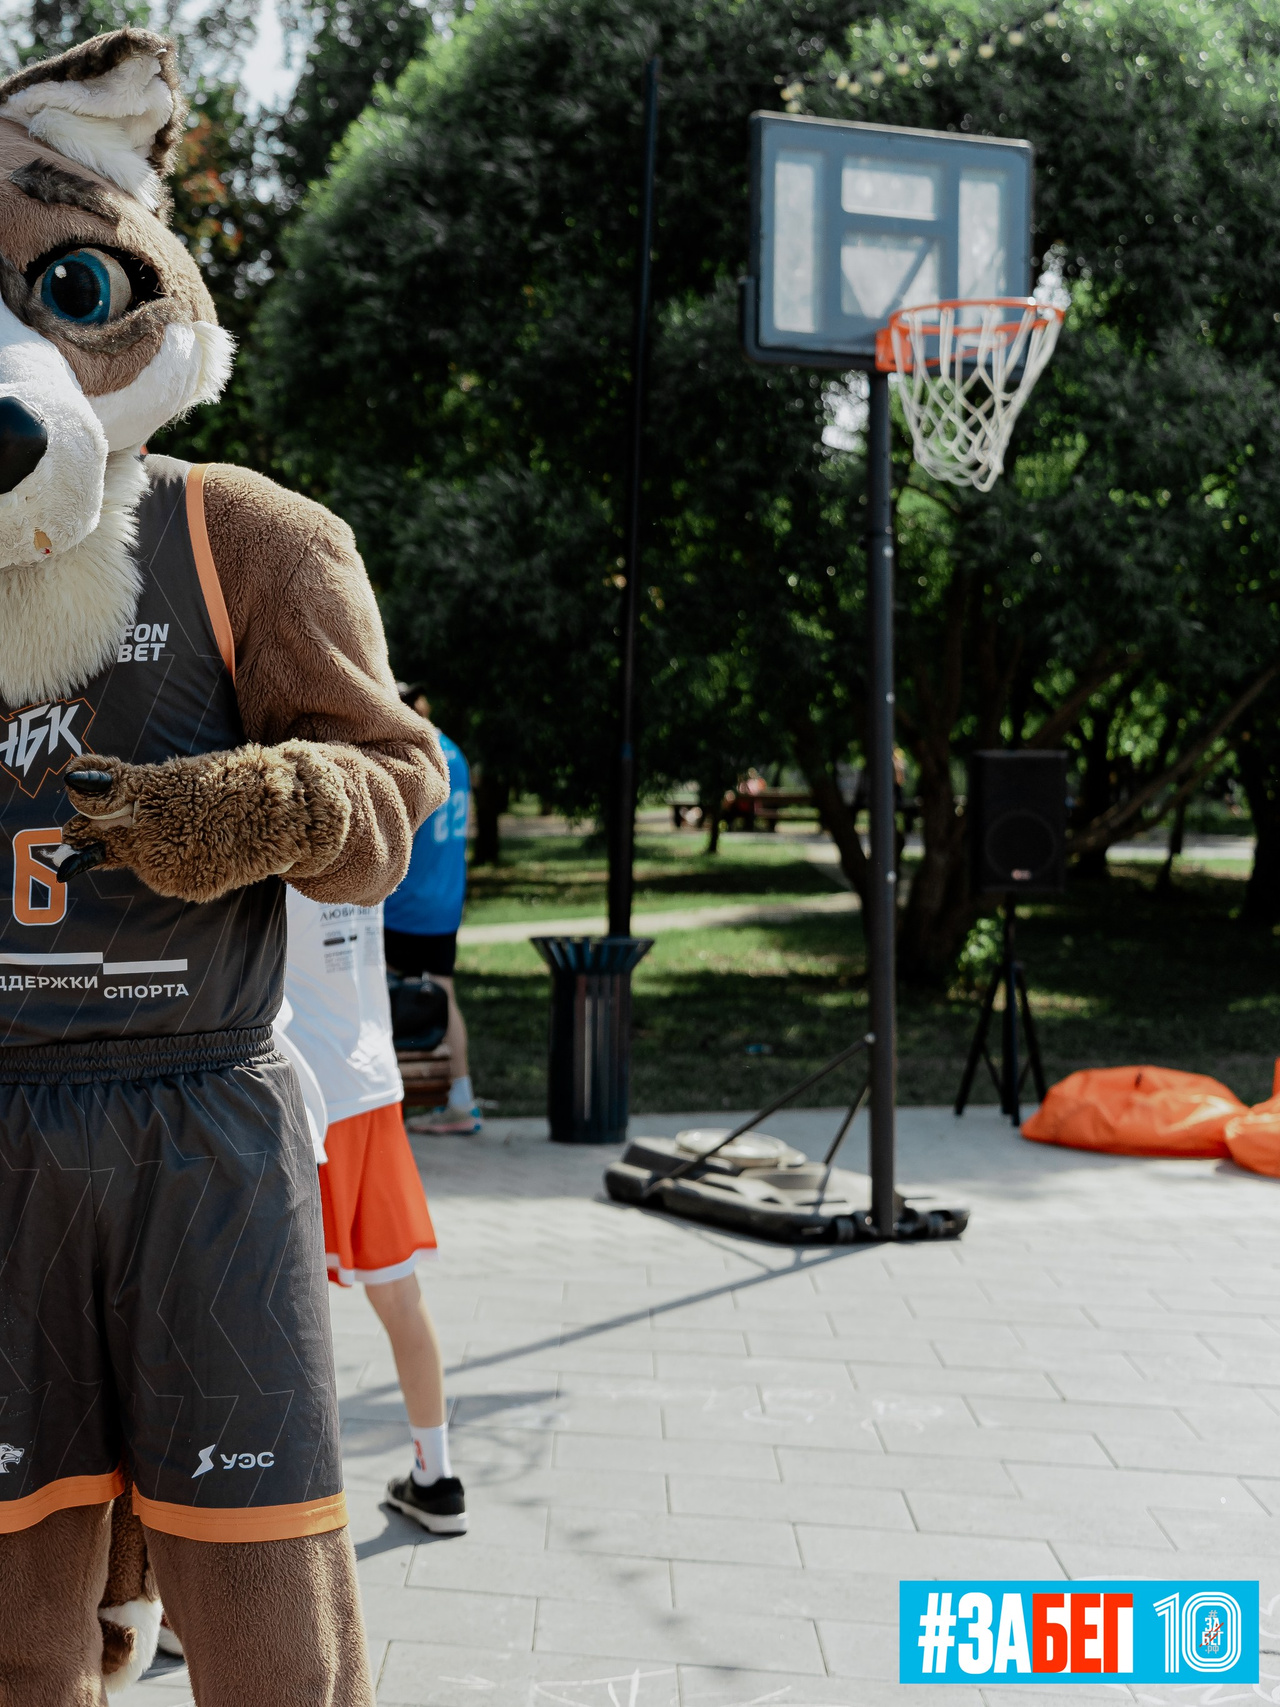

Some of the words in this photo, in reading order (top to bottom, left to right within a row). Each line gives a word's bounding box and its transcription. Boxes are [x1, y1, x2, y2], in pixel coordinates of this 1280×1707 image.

[120, 623, 169, 644] FON
[117, 643, 166, 663] BET
[12, 827, 68, 926] 6
[103, 983, 189, 999] СПОРТА
[220, 1451, 275, 1470] УЭС
